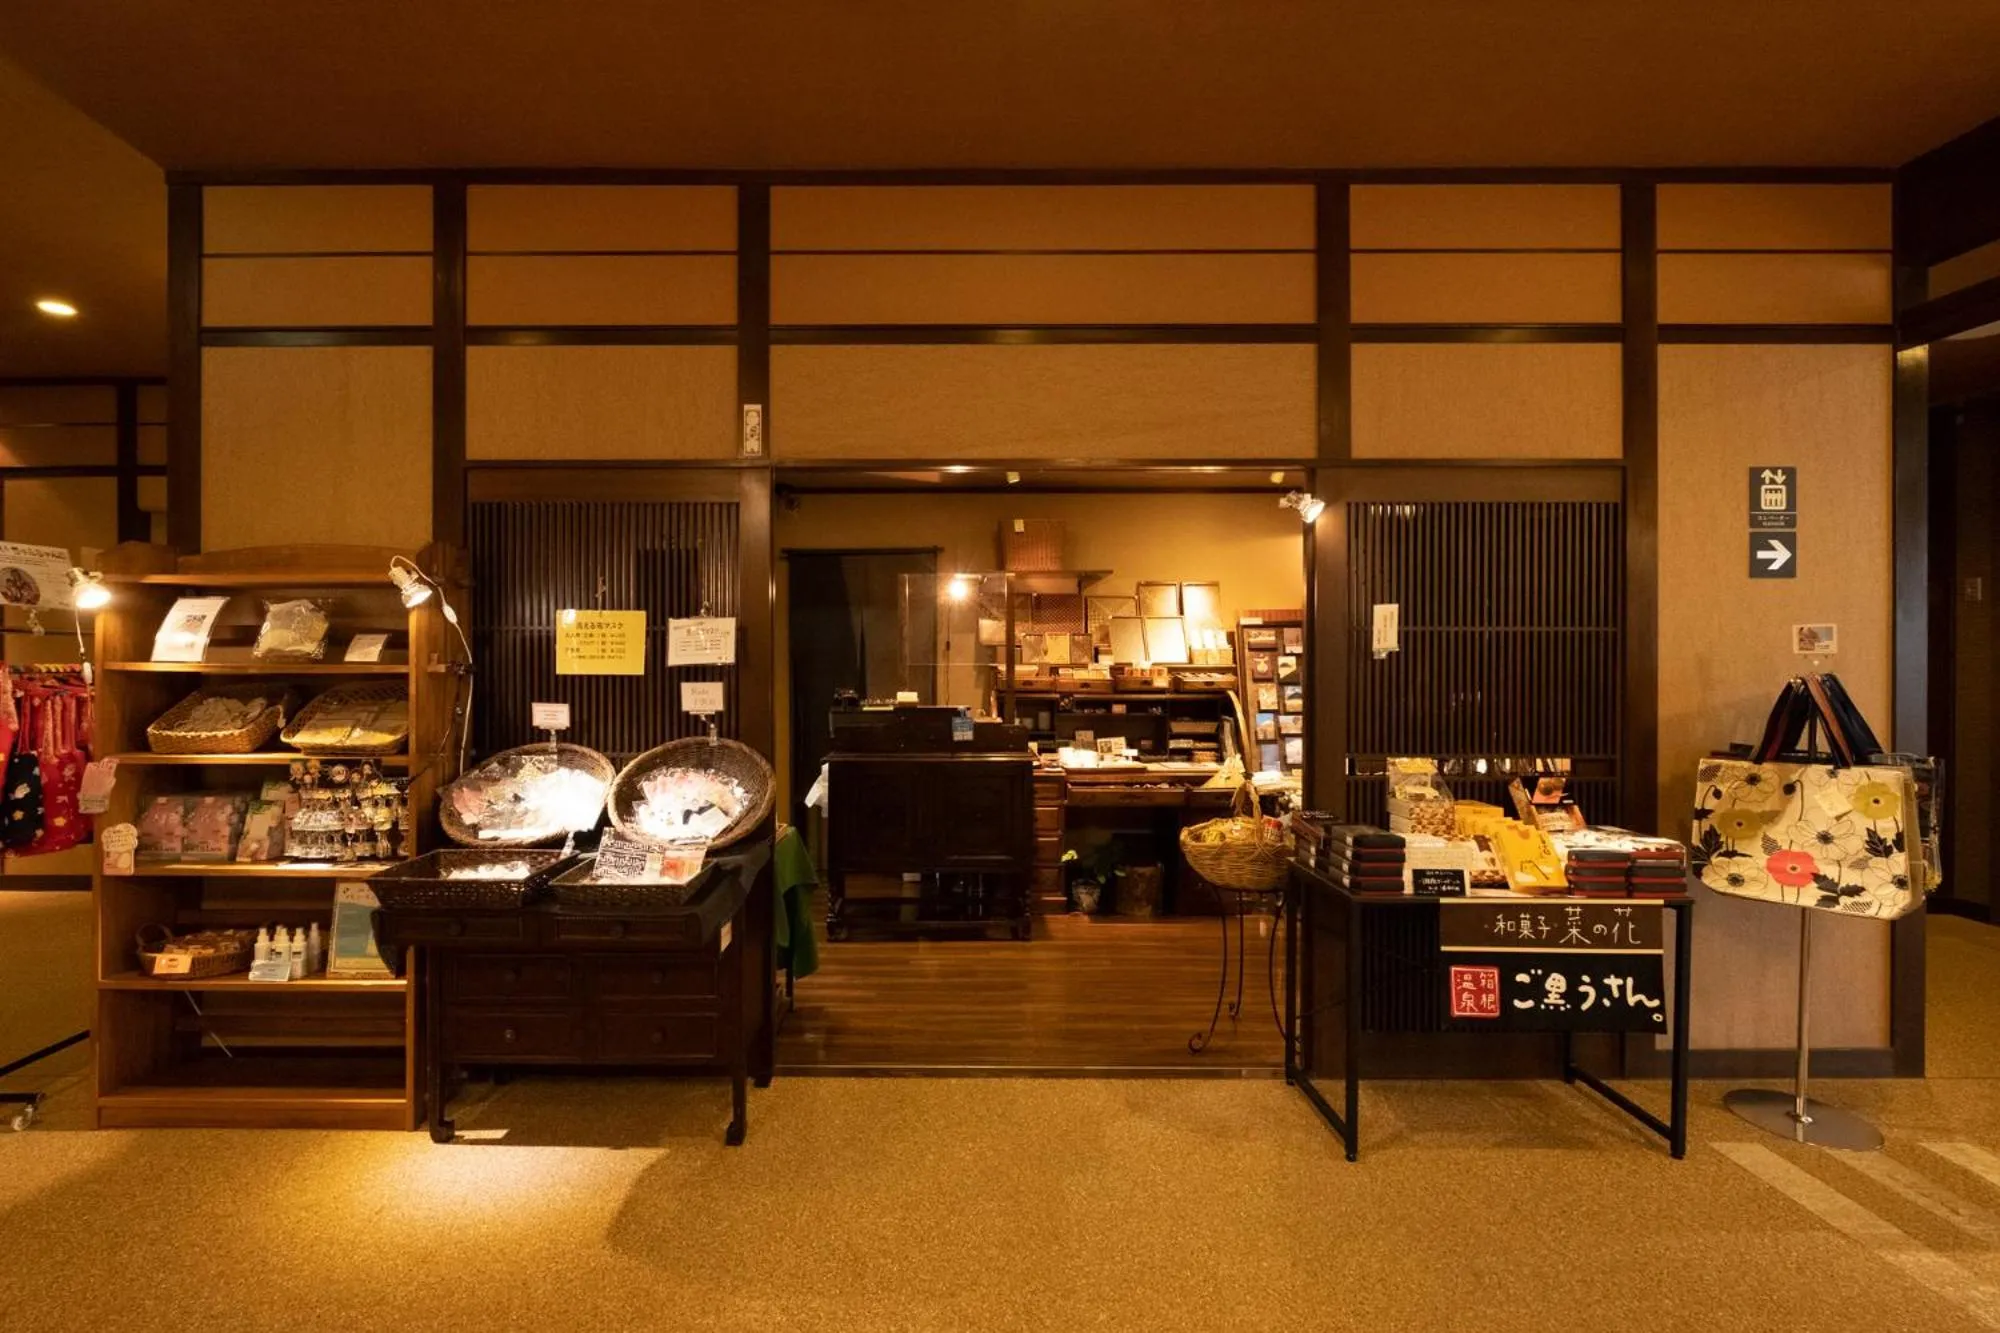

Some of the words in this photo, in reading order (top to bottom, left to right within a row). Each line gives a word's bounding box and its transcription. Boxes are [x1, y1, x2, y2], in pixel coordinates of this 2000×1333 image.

[1494, 913, 1551, 939] 和菓子
[1559, 906, 1642, 944] 菜の花
